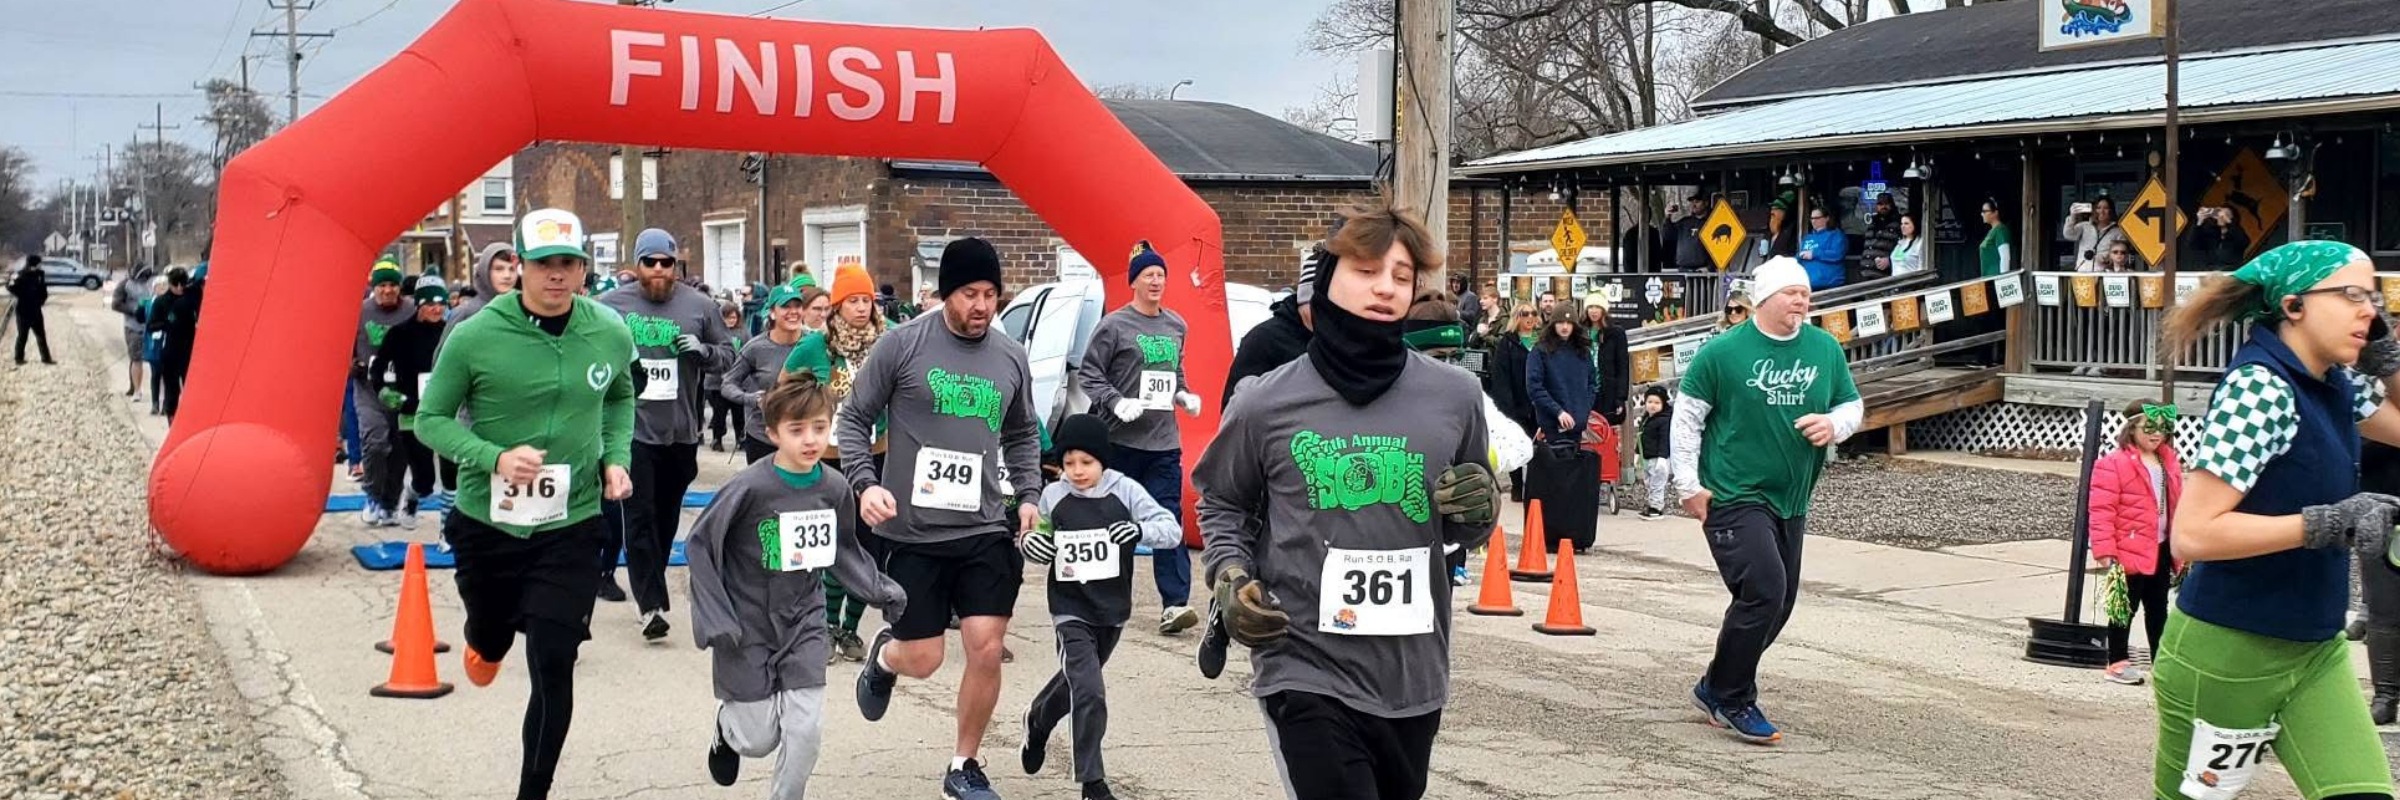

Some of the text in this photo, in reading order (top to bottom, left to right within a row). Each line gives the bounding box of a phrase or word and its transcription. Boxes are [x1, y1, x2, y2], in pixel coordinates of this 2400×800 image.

[610, 29, 957, 123] FINISH
[1999, 288, 2018, 298] LIGHT
[2000, 283, 2015, 291] BUD
[1929, 304, 1949, 314] LIGHT
[1930, 299, 1946, 308] BUD
[1860, 318, 1880, 328] LIGHT
[1862, 313, 1877, 321] BUD
[1679, 349, 1695, 357] BUD
[642, 367, 671, 381] 90
[1746, 358, 1819, 391] Lucky
[1148, 378, 1171, 393] 301
[1766, 391, 1805, 405] Shirt
[1320, 434, 1407, 454] 7th Annual
[927, 460, 973, 485] 349
[1315, 451, 1406, 510] SOB
[503, 478, 556, 498] 316
[794, 523, 831, 549] 333
[1064, 540, 1108, 563] 350
[1343, 554, 1364, 564] Run
[1342, 568, 1413, 605] 361
